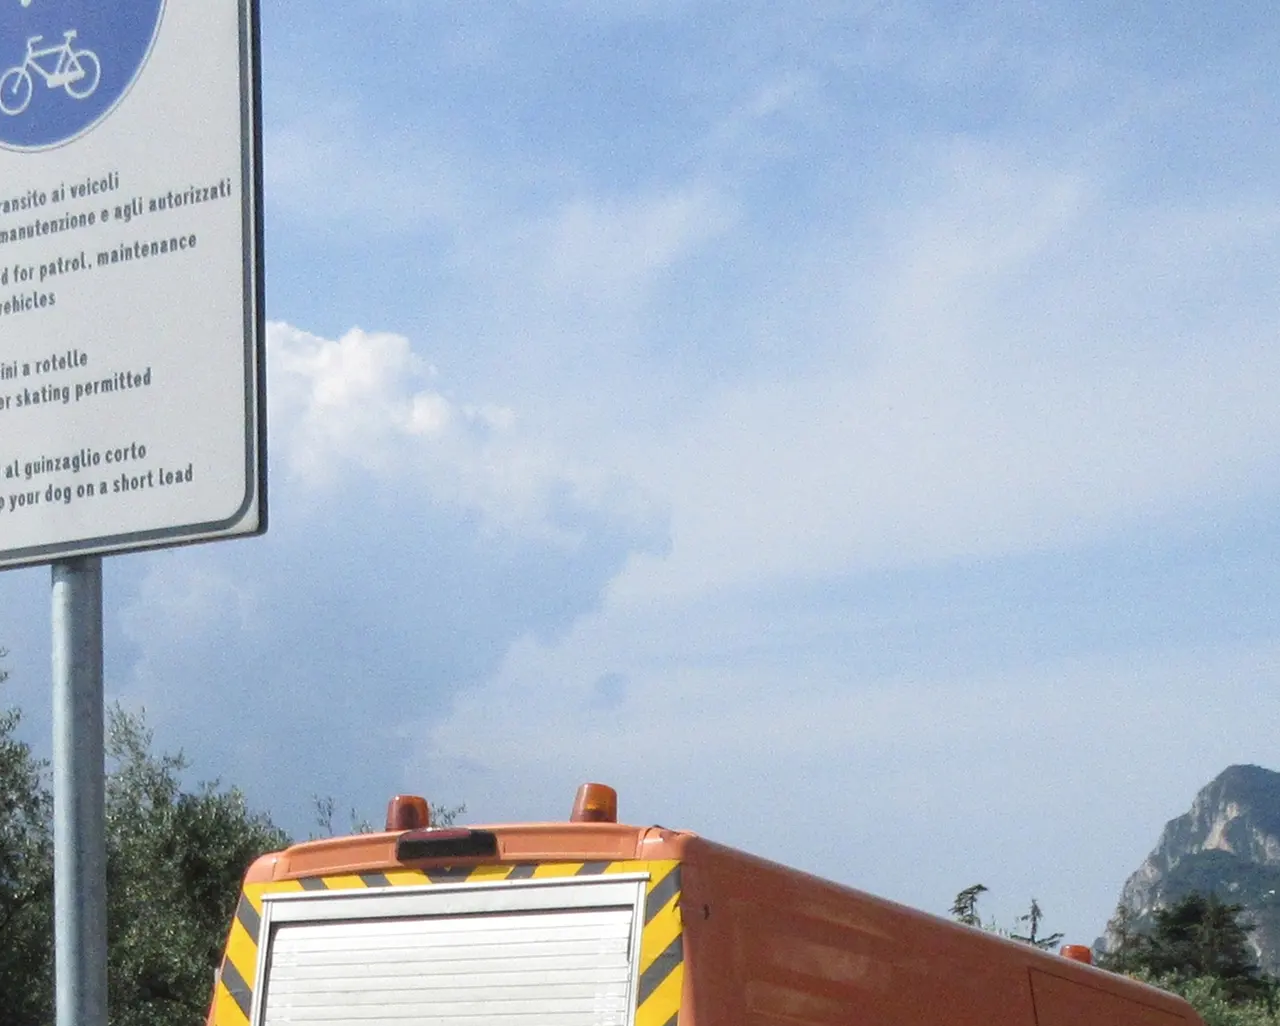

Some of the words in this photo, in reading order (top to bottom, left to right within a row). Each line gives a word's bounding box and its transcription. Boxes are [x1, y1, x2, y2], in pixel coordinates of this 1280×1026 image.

[51, 183, 65, 202] ai
[70, 171, 119, 199] veicoli
[101, 209, 109, 222] e
[114, 197, 143, 223] agli
[149, 178, 232, 213] autorizzati
[14, 264, 34, 283] for
[97, 234, 197, 266] maintenance
[22, 363, 30, 376] a
[36, 350, 88, 374] rotelle
[16, 384, 69, 404] skating
[75, 367, 151, 401] permitted
[6, 460, 19, 479] al
[25, 448, 100, 480] guinzaglio
[105, 442, 146, 463] corto
[9, 491, 40, 512] your
[45, 483, 71, 504] dog
[77, 483, 94, 497] on
[100, 481, 107, 495] a
[113, 471, 153, 493] short
[159, 463, 193, 486] lead
